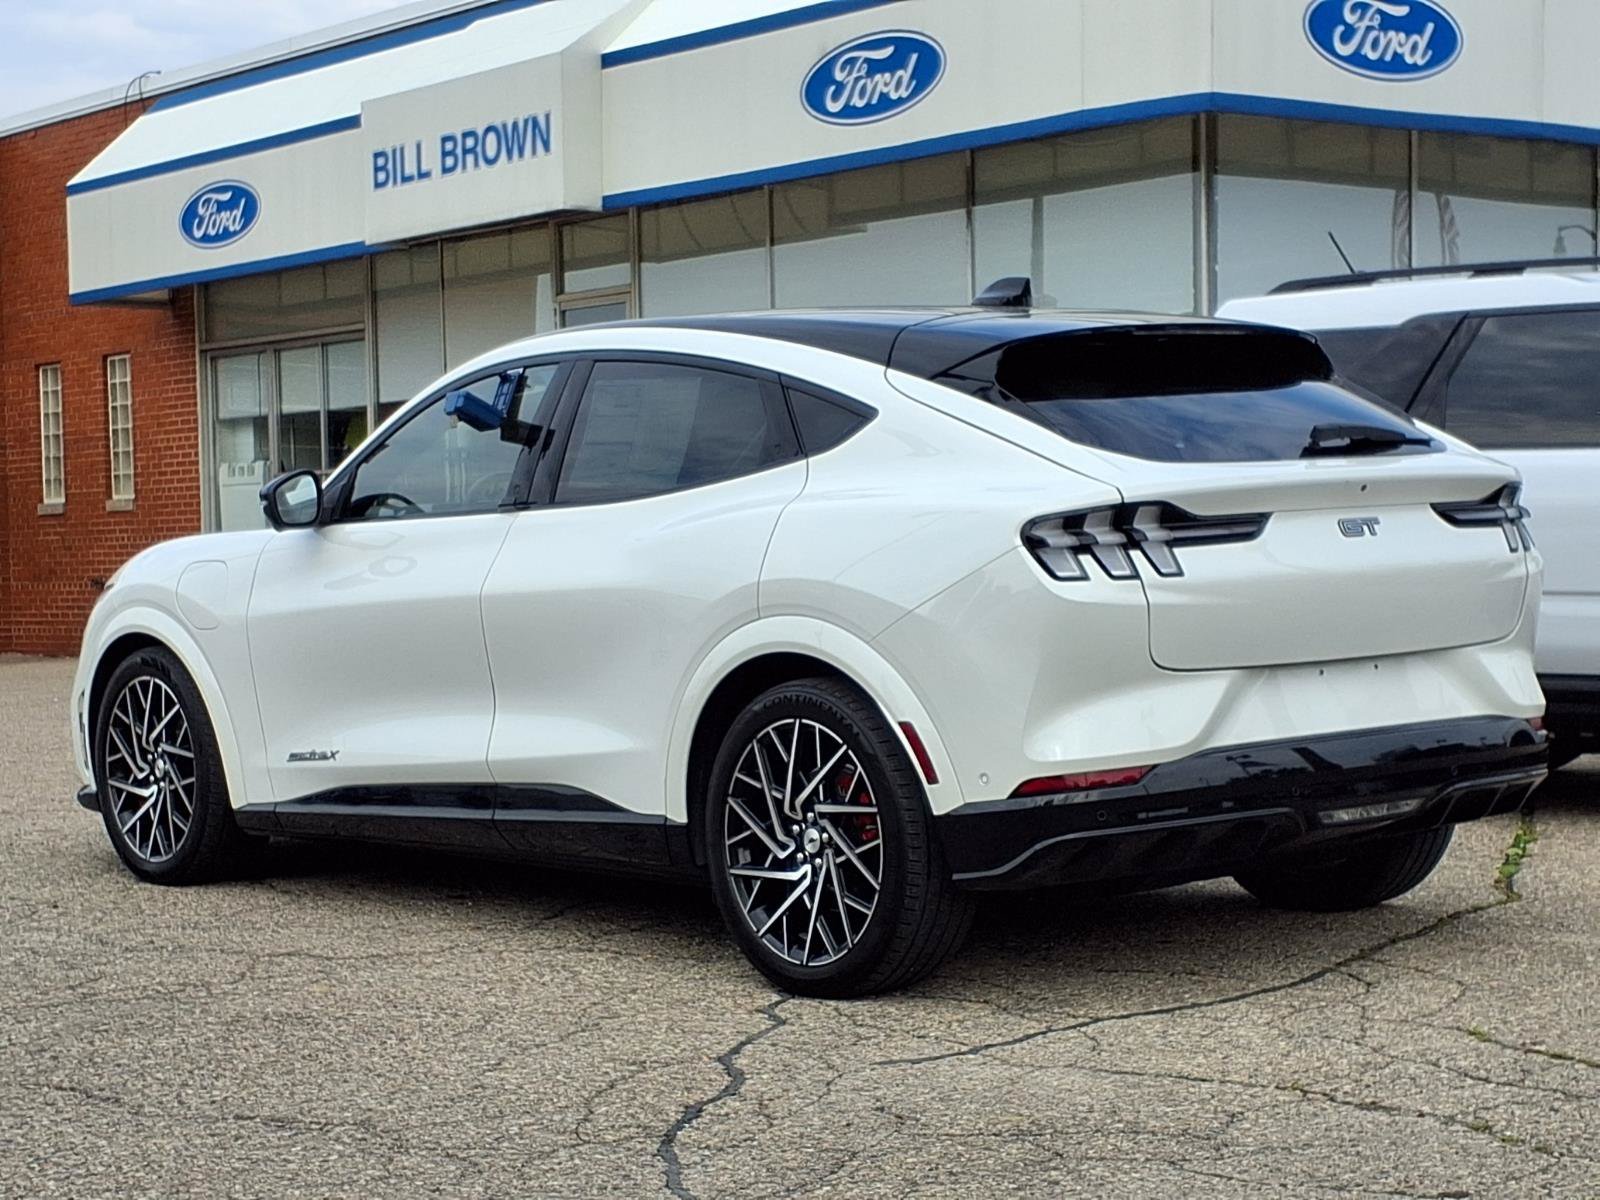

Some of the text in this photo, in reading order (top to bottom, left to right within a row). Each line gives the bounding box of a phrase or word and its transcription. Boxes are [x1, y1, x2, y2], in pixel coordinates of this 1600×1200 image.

[1332, 0, 1435, 66] Ford
[825, 45, 919, 113] Ford
[373, 110, 552, 191] BILL BROWN
[193, 190, 246, 239] Ford
[1337, 516, 1381, 538] GT
